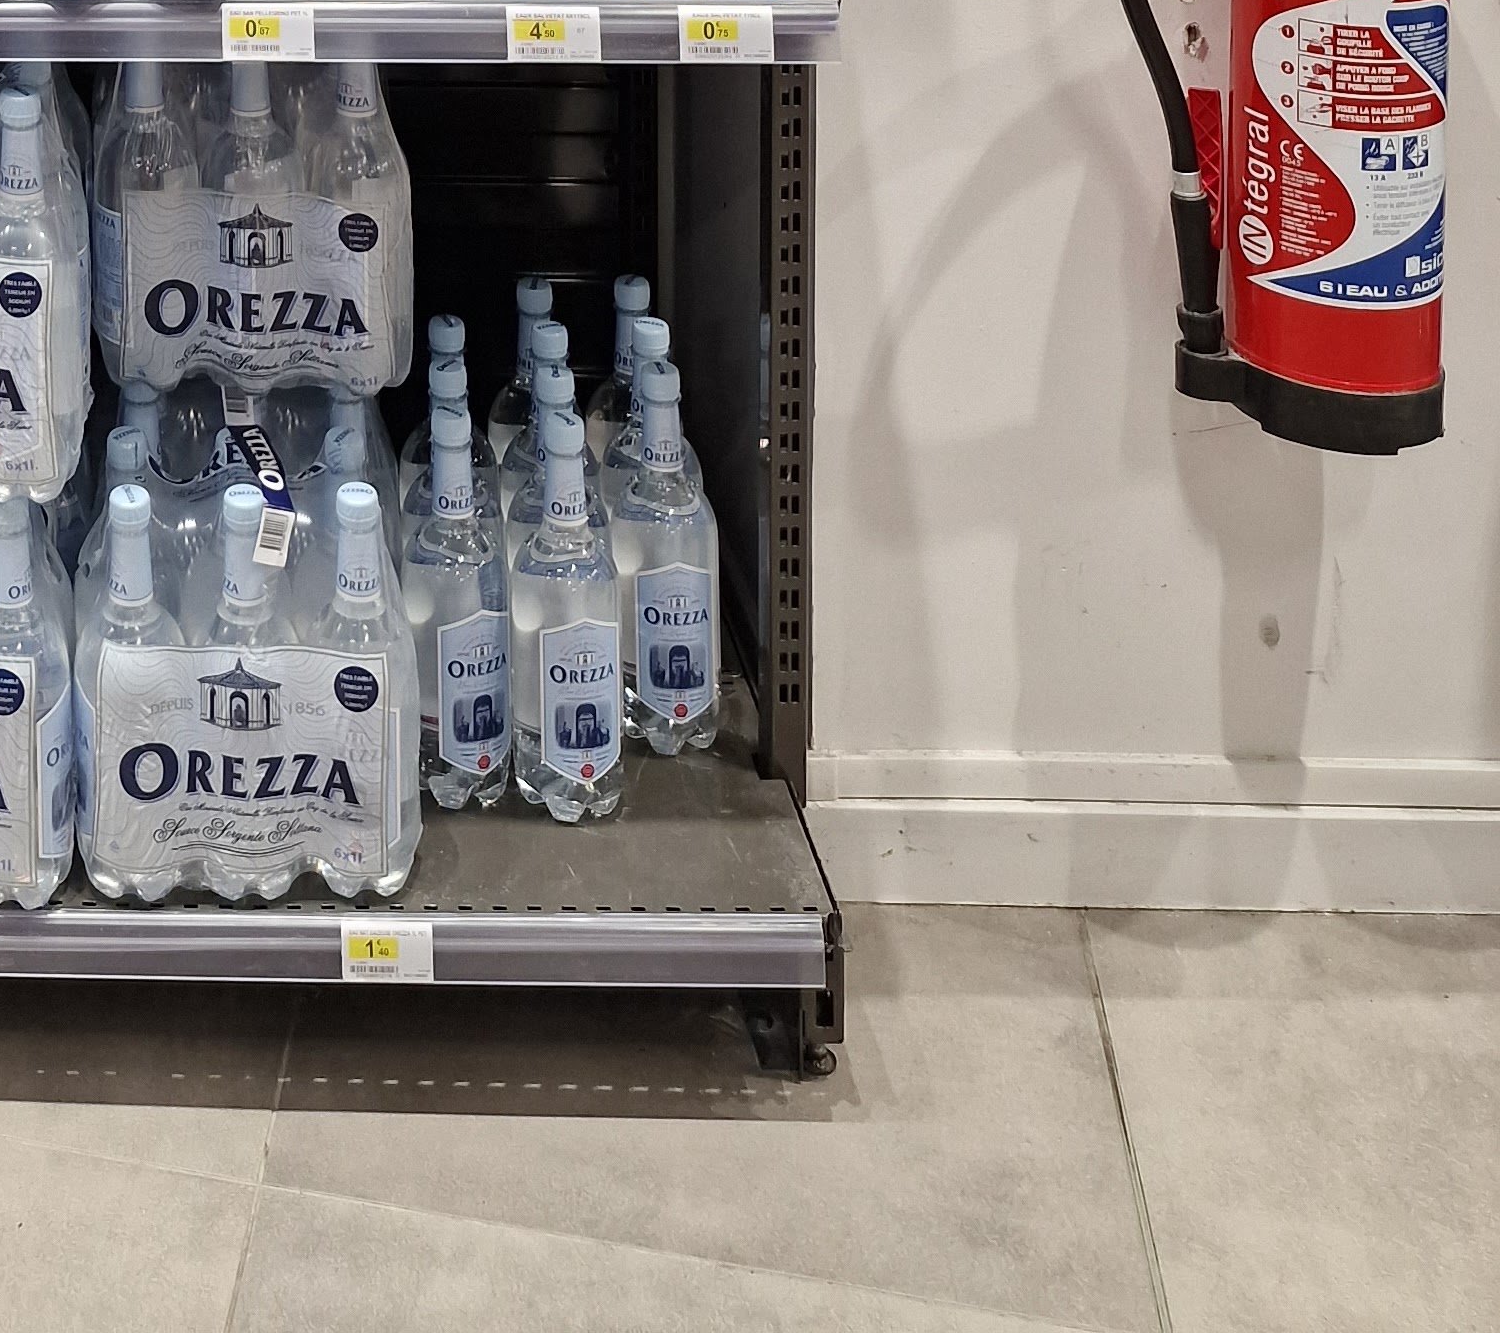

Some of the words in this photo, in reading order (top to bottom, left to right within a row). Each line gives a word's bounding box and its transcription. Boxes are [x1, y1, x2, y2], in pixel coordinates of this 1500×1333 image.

[1284, 63, 1291, 72] 2
[1385, 138, 1396, 151] A
[1421, 134, 1429, 147] B
[1346, 285, 1388, 297] EAU
[1395, 284, 1408, 297] &
[143, 278, 369, 337] OREZZA
[242, 426, 285, 492] OREZZA
[644, 606, 709, 626] OREZZA
[549, 661, 614, 684] OREZZA
[150, 698, 194, 716] DEPUIS
[118, 742, 361, 807] OREZZA
